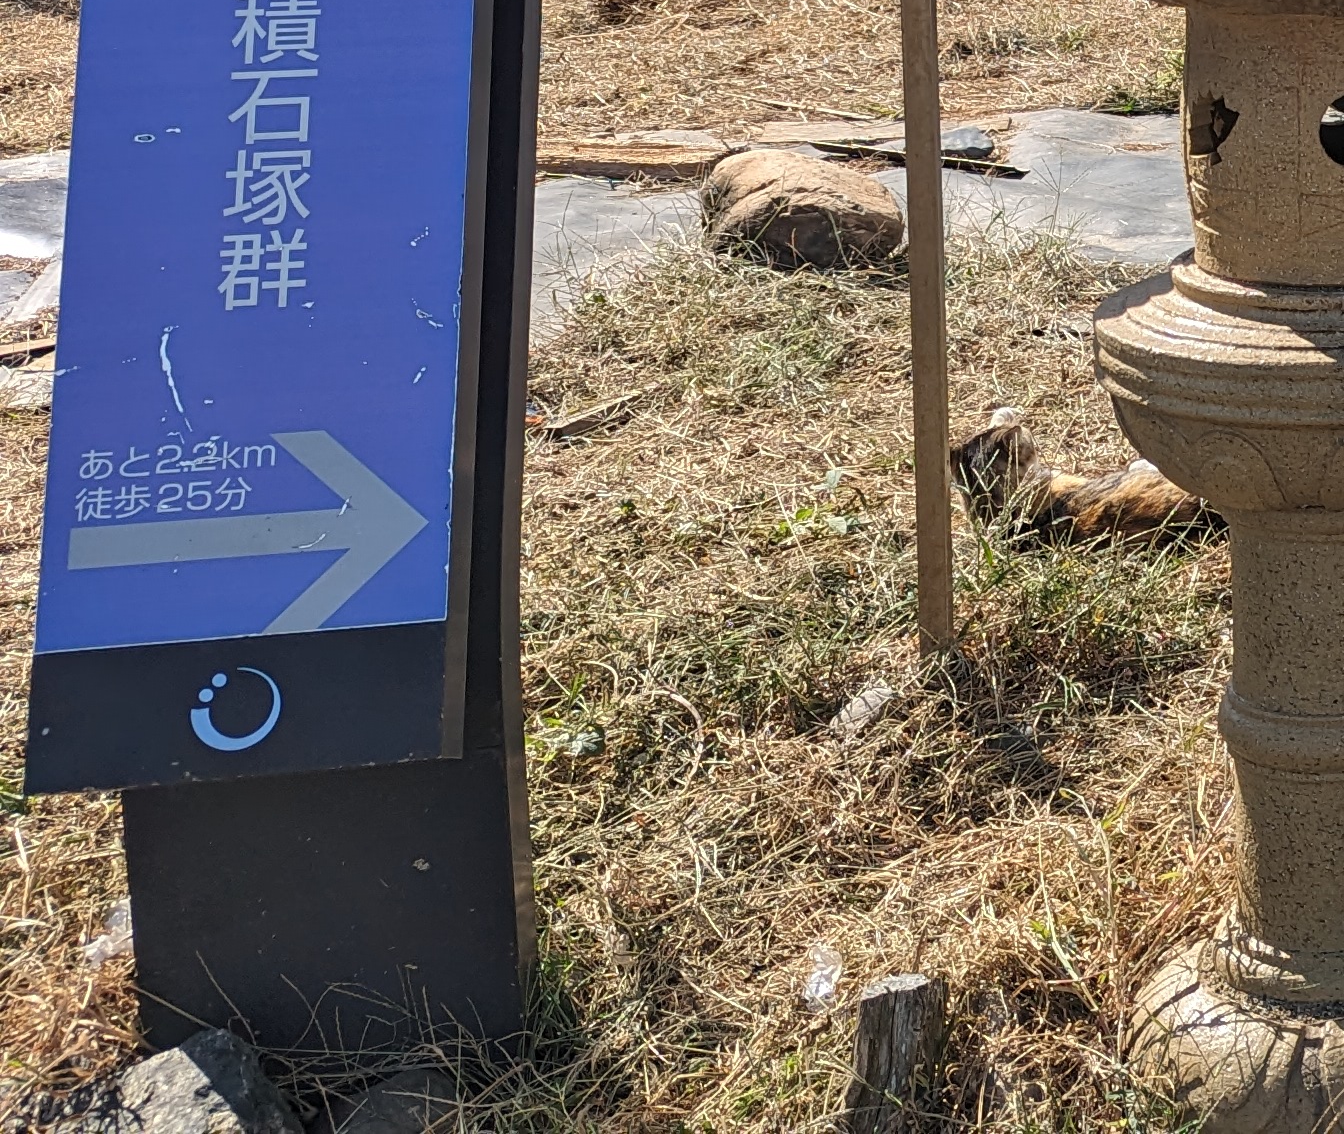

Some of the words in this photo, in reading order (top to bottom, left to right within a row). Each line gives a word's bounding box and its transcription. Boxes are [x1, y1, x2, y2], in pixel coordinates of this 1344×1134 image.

[79, 440, 276, 480] あと2.2km
[74, 476, 253, 522] 徒歩25分
